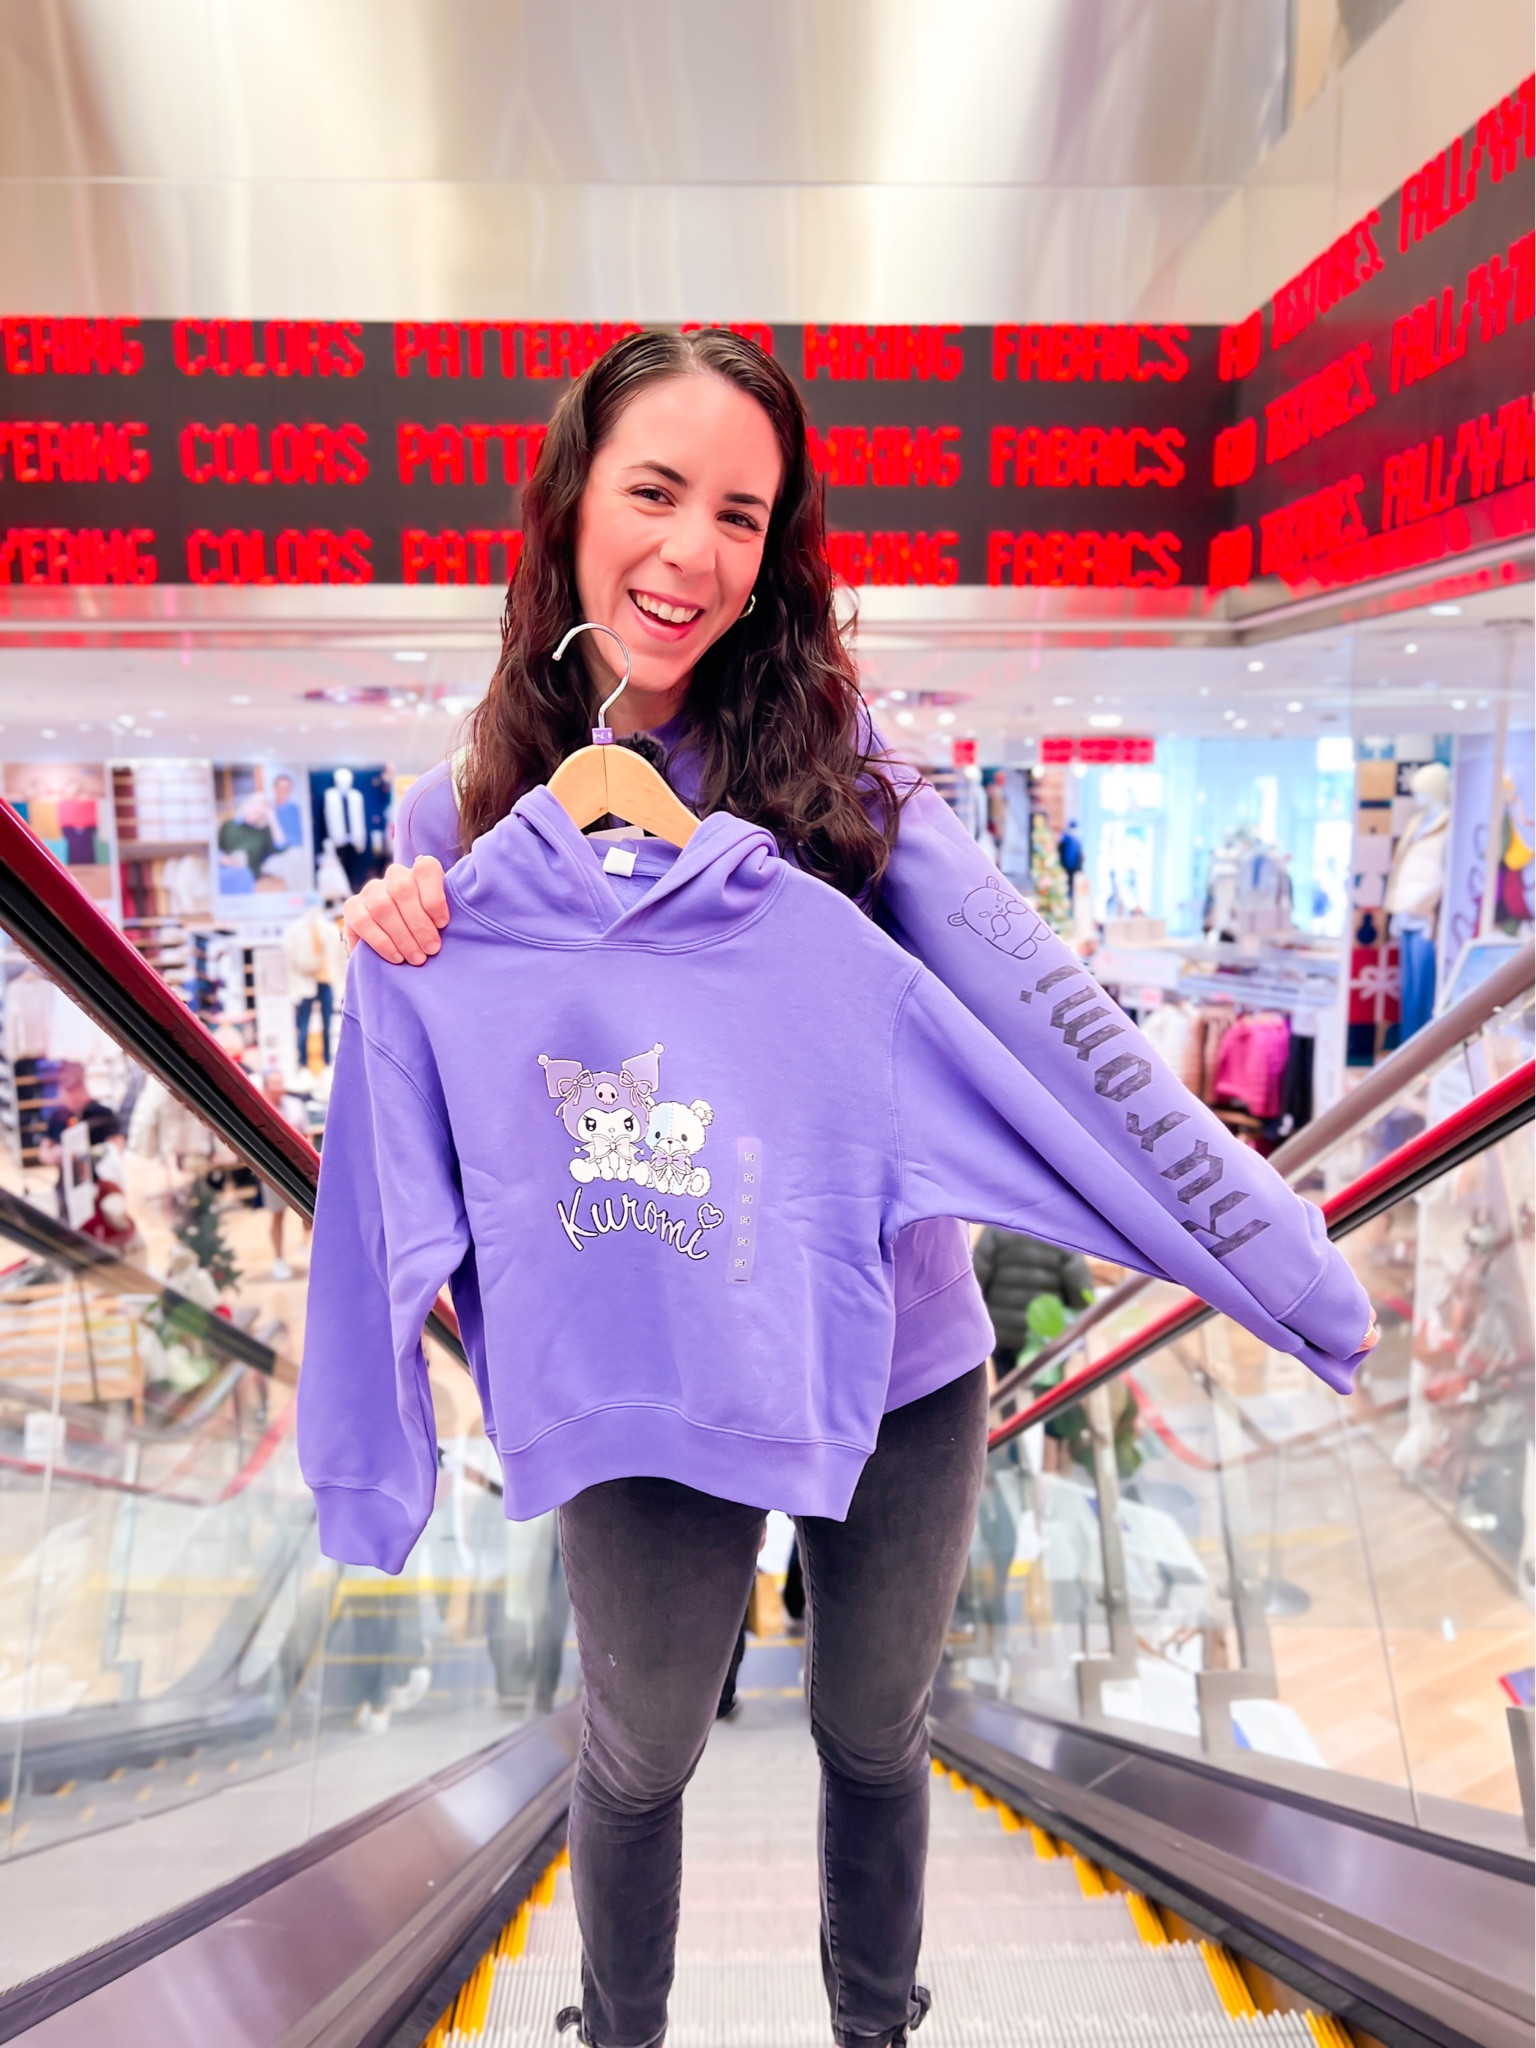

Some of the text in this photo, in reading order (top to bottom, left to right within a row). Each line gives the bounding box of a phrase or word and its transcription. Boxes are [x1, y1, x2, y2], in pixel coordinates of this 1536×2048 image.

[0, 315, 144, 376] ERING
[173, 318, 364, 377] COLORS
[394, 319, 642, 379] PATTERN
[803, 323, 963, 381] MIXING
[992, 323, 1190, 382] FABRICS
[180, 422, 369, 485] COLORS
[990, 426, 1186, 487] FABRICS
[186, 529, 373, 586] COLORS
[402, 529, 525, 586] PATT
[987, 530, 1182, 587] FABRICS
[1019, 964, 1273, 1260] Kuromi
[556, 1186, 724, 1261] Kuromi
